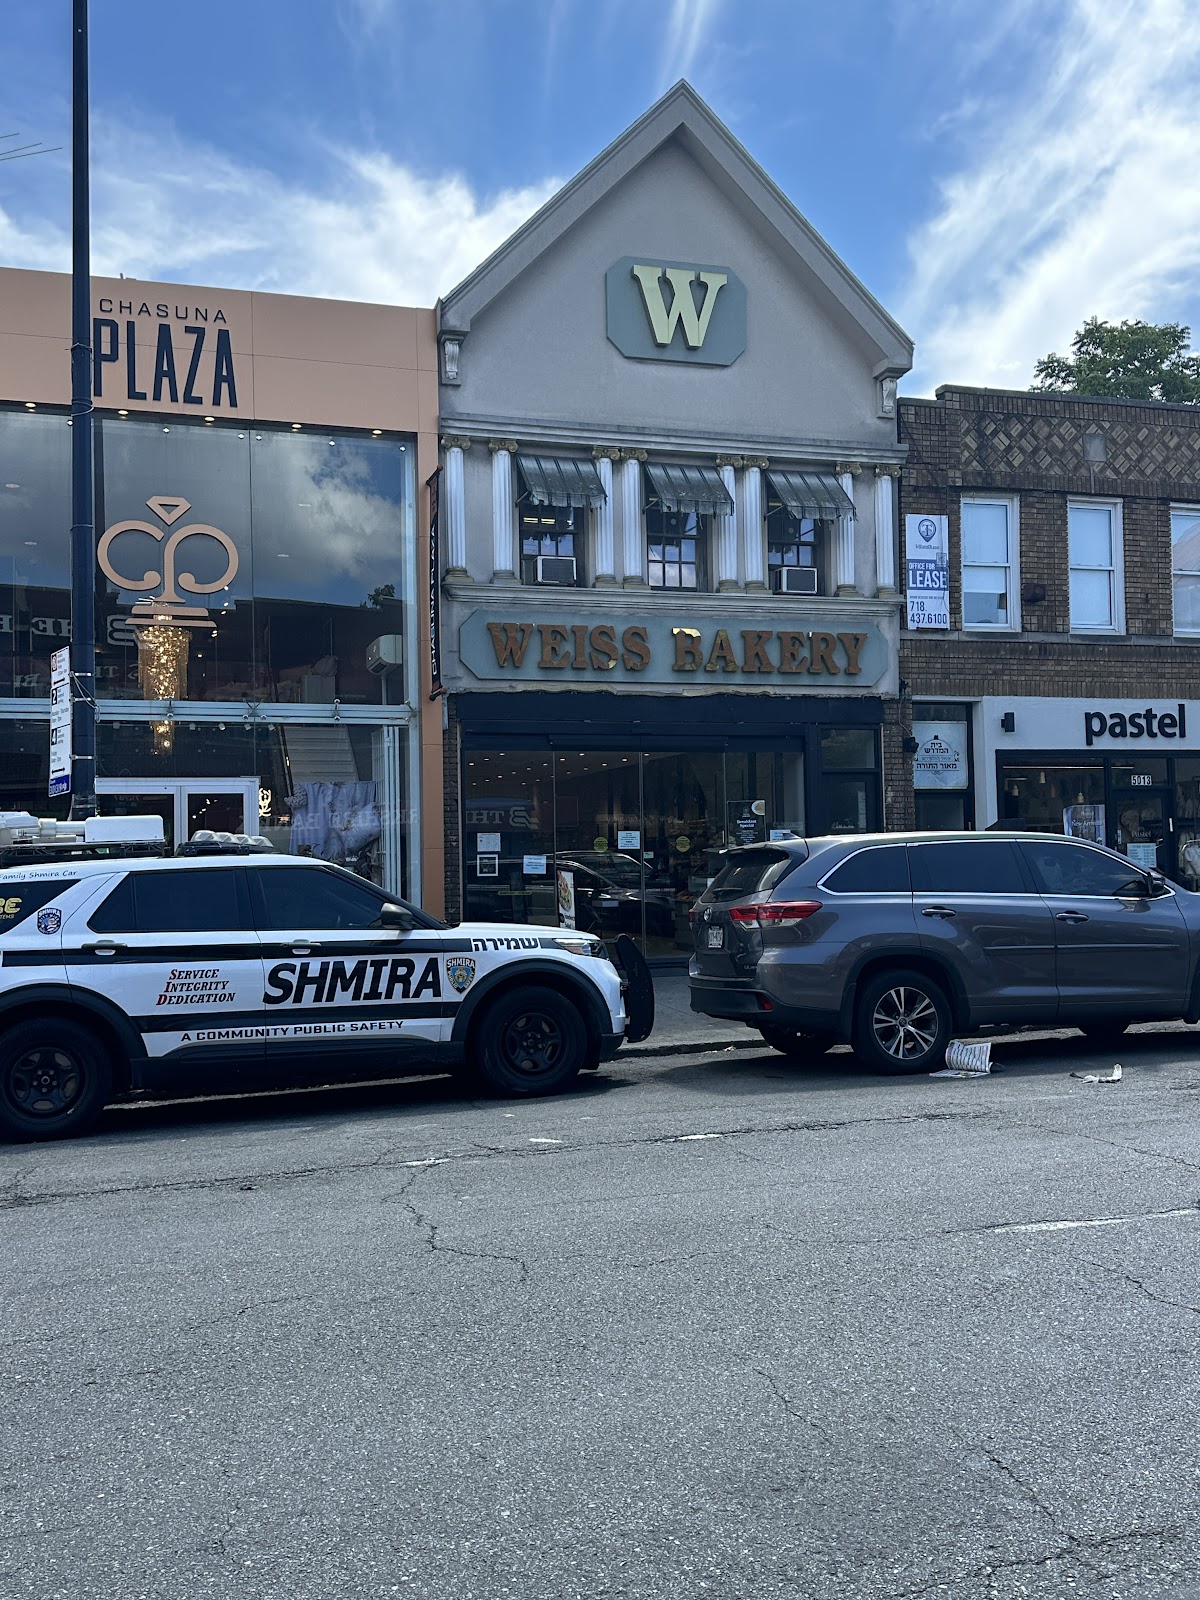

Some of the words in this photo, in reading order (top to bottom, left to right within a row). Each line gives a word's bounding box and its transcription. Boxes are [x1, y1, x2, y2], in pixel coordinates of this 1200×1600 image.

[99, 298, 227, 324] CHASUNA
[631, 265, 728, 350] W
[93, 317, 238, 408] PLAZA
[908, 562, 925, 570] OFFICE
[926, 562, 936, 571] FOR
[909, 570, 948, 589] LEASE
[909, 601, 928, 612] 718.
[910, 613, 948, 625] 437.6100
[487, 622, 651, 670] WEISS
[672, 627, 869, 675] BAKERY
[1085, 704, 1186, 746] pastel
[1132, 775, 1152, 786] 5013
[472, 937, 539, 952] שמירה
[447, 958, 476, 969] SHMIRA
[169, 968, 220, 980] SERVICE
[262, 957, 442, 1005] SHMIRA
[163, 980, 230, 993] INTEGRITY
[155, 992, 236, 1006] DEDICATION
[181, 1033, 192, 1042] A
[196, 1026, 289, 1041] COMMUNITY
[293, 1024, 347, 1035] PUBLIC
[350, 1020, 404, 1032] SAFETY
